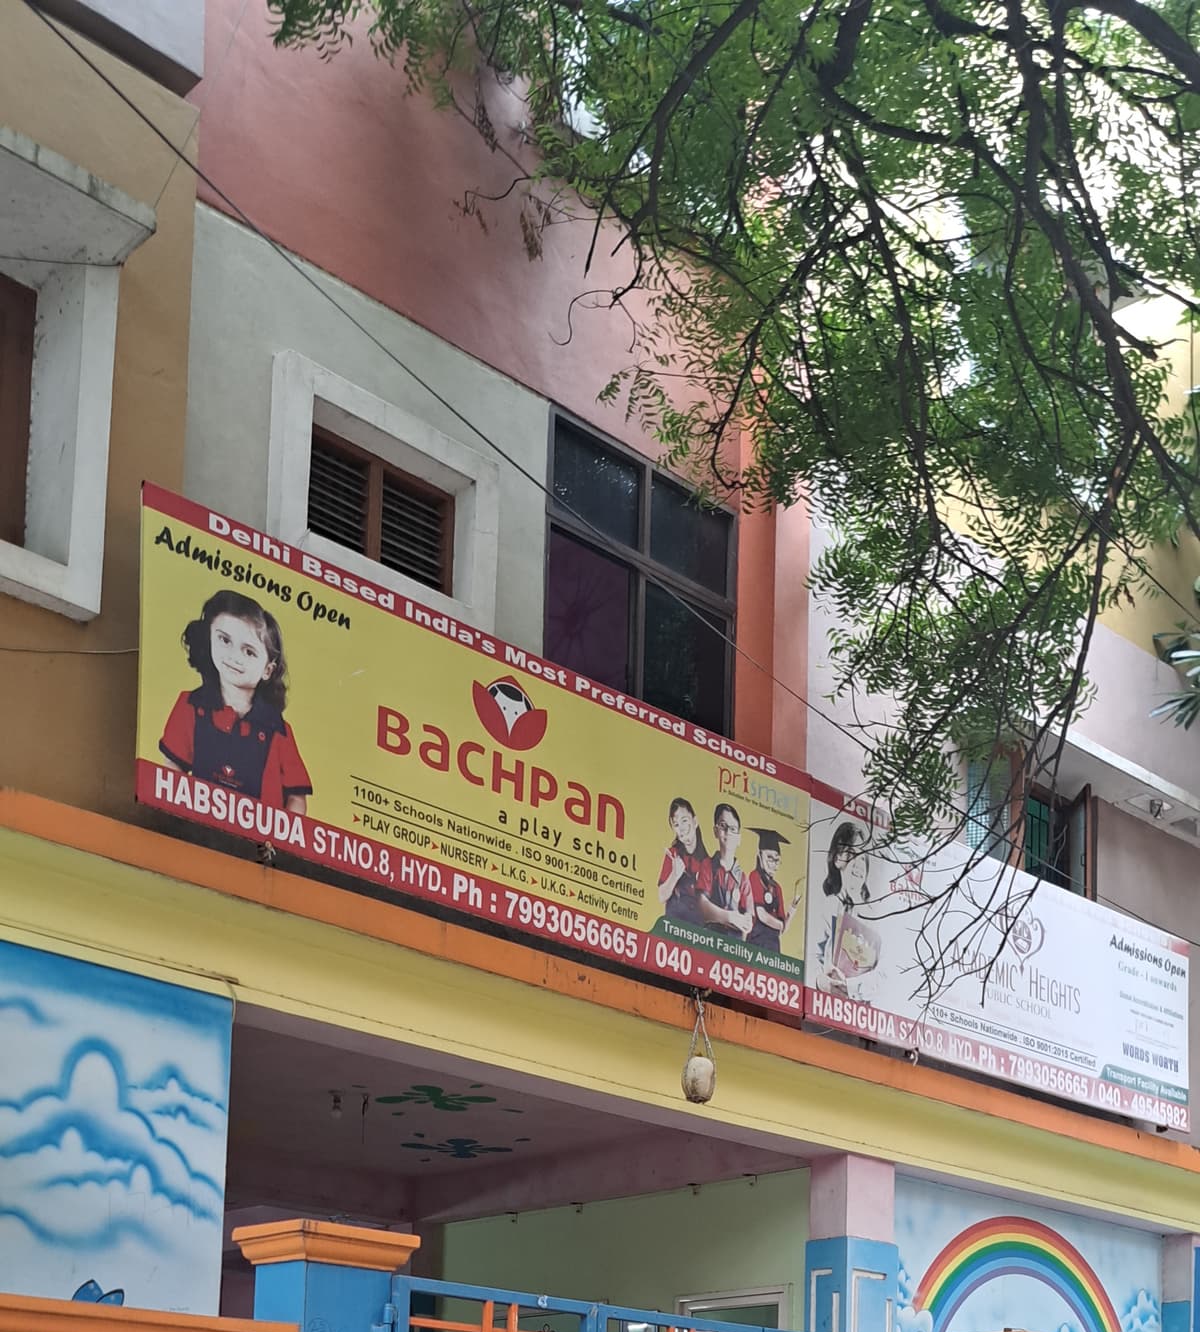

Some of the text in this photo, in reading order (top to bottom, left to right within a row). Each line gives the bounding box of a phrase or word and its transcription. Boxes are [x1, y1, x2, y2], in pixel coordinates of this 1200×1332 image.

[154, 526, 351, 630] Admissions Open
[208, 512, 777, 775] Delhi Based India's Most Preferred Schools
[353, 785, 390, 807] 1100+
[393, 800, 444, 827] Schools
[447, 819, 512, 852] Nationwide
[521, 846, 542, 862] ISO
[544, 854, 598, 882] 9001:2008
[601, 874, 645, 898] Certified
[363, 814, 639, 921] PLAY GROUP NURSERY L.K.G. U.K.G. Activity Centre
[498, 809, 637, 872] a play school
[154, 767, 307, 849] HABSIGUDA
[401, 856, 447, 896] HYD.
[452, 873, 483, 909] Ph
[504, 890, 638, 959] 7993056665
[655, 941, 692, 976] 040
[709, 960, 800, 1009] 49545982
[663, 919, 801, 975] Transport Facility Available
[1109, 933, 1187, 979] Admissions Open
[983, 986, 1013, 1006] UBLIC
[1029, 965, 1081, 1015] HEIGHTS
[812, 991, 896, 1039] HABSIGUDA
[979, 1045, 996, 1070] Ph
[1008, 1055, 1088, 1098] 7993056665
[1098, 1083, 1121, 1107] 040
[1130, 1093, 1187, 1128] 49545982
[949, 1012, 979, 1029] Schools
[980, 1022, 1018, 1042] Nationwide
[1022, 1036, 1036, 1049] ISO
[1069, 1051, 1097, 1068] Certified
[1122, 1042, 1179, 1073] WORDS WORTH
